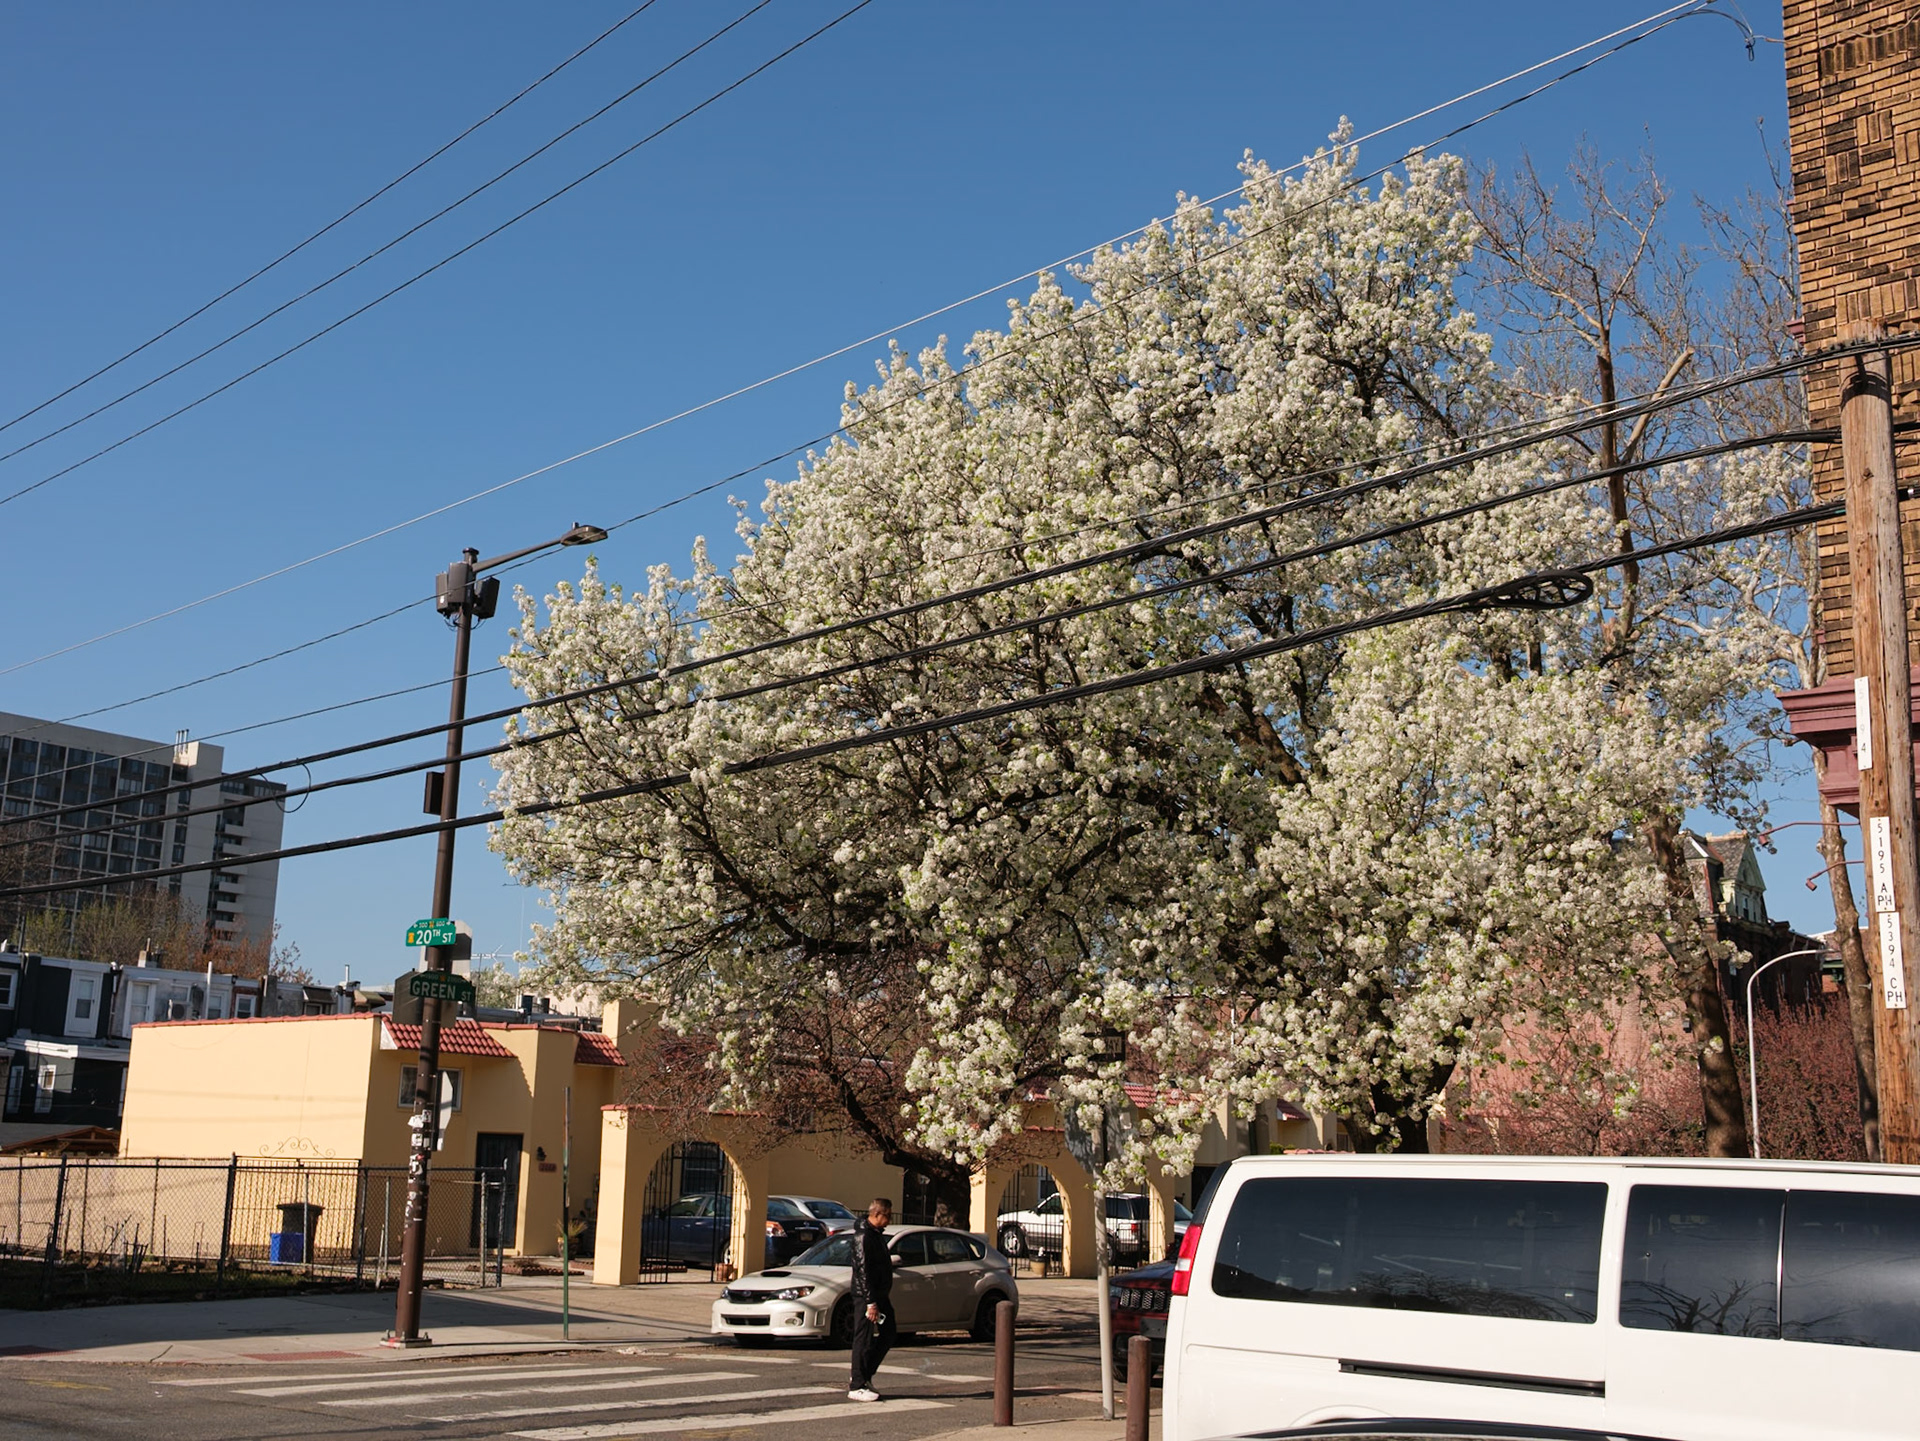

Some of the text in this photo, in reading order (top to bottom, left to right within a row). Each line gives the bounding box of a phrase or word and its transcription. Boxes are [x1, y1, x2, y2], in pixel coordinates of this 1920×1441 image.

[1877, 822, 1893, 907] 5195 A PH
[416, 929, 452, 945] 20TH ST
[1886, 917, 1903, 1003] 5394 C PH
[412, 980, 471, 1001] GREEN ST
